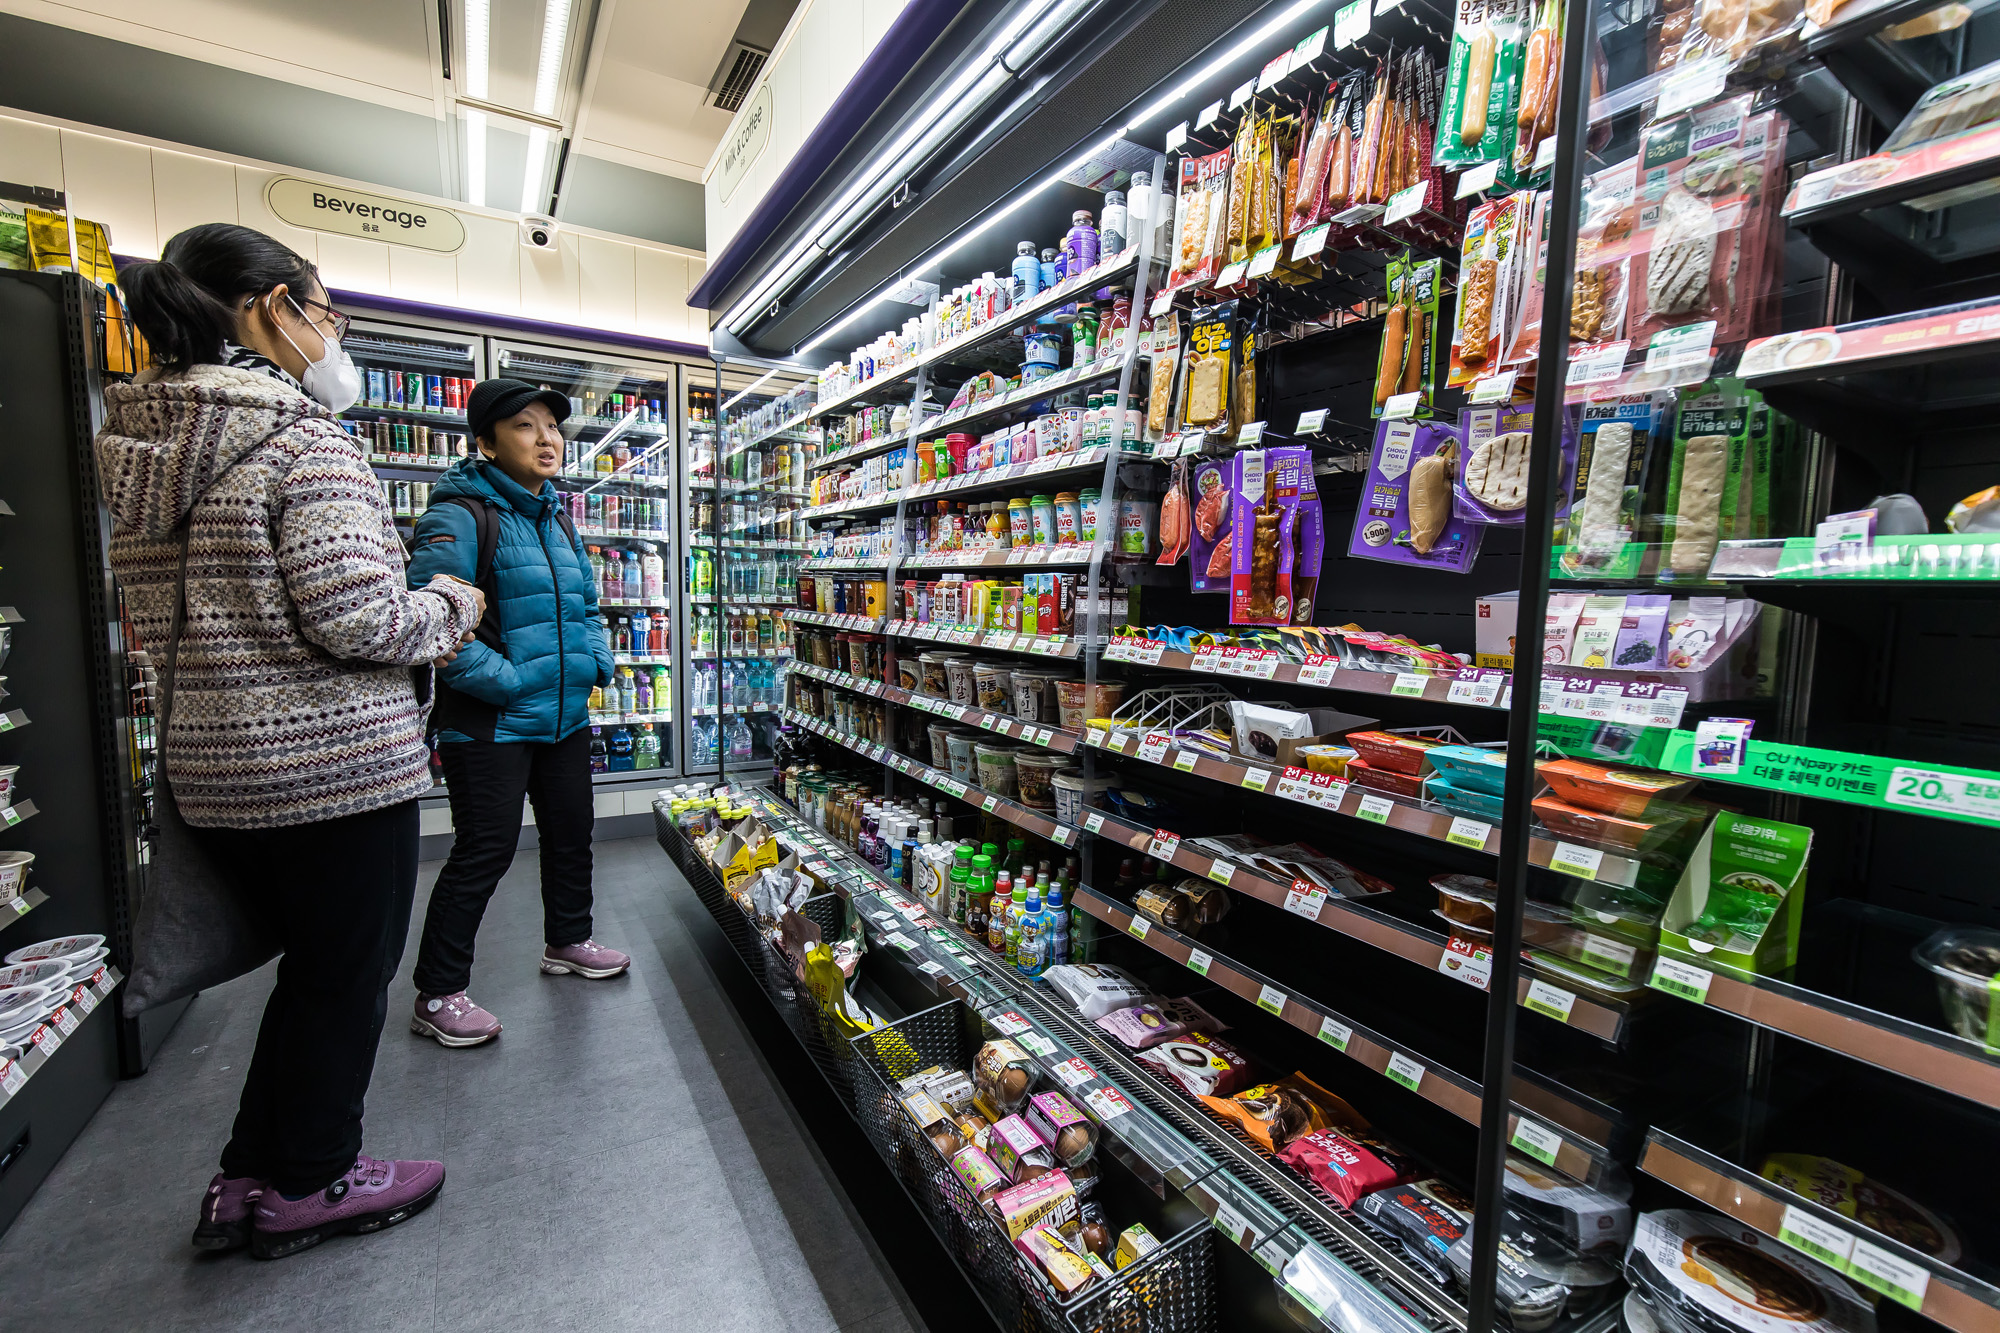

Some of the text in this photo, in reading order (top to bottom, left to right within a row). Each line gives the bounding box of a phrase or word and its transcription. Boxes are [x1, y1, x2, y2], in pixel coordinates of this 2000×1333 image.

[1694, 117, 1739, 140] 닭가슴살
[725, 146, 737, 176] Milk
[736, 139, 742, 156] &
[742, 106, 763, 149] Coffee
[313, 193, 427, 229] Beverage
[362, 222, 380, 233] 음료
[1579, 346, 1601, 356] 2+1
[1586, 407, 1617, 419] 닭가슴살
[1682, 422, 1728, 433] 닭가슴살
[1374, 486, 1401, 496] 닭가슴살
[1199, 646, 1211, 655] 2+1
[1225, 647, 1237, 657] 2+1
[1250, 650, 1263, 660] 2+1
[1459, 669, 1478, 678] 2+1
[981, 680, 996, 693] 우동
[1568, 678, 1592, 690] 2+1
[1628, 683, 1656, 695] 2+1
[1147, 735, 1158, 745] 2+1
[1766, 752, 1873, 777] CU Npay 카드
[1286, 768, 1300, 777] 2+1
[1313, 773, 1329, 784] 2+1
[1753, 765, 1784, 782] 더블
[1825, 775, 1878, 796] 이벤트
[1897, 776, 1955, 803] 20%
[1157, 830, 1168, 839] 2+1
[1731, 822, 1777, 841] 상큼키위
[1294, 880, 1310, 892] 2+1
[1452, 938, 1472, 953] 2+1
[1072, 1058, 1085, 1069] 2+1
[1224, 1051, 1247, 1066] 호빵
[1105, 1088, 1120, 1099] 2+1
[1305, 1133, 1360, 1165] 고추잡채
